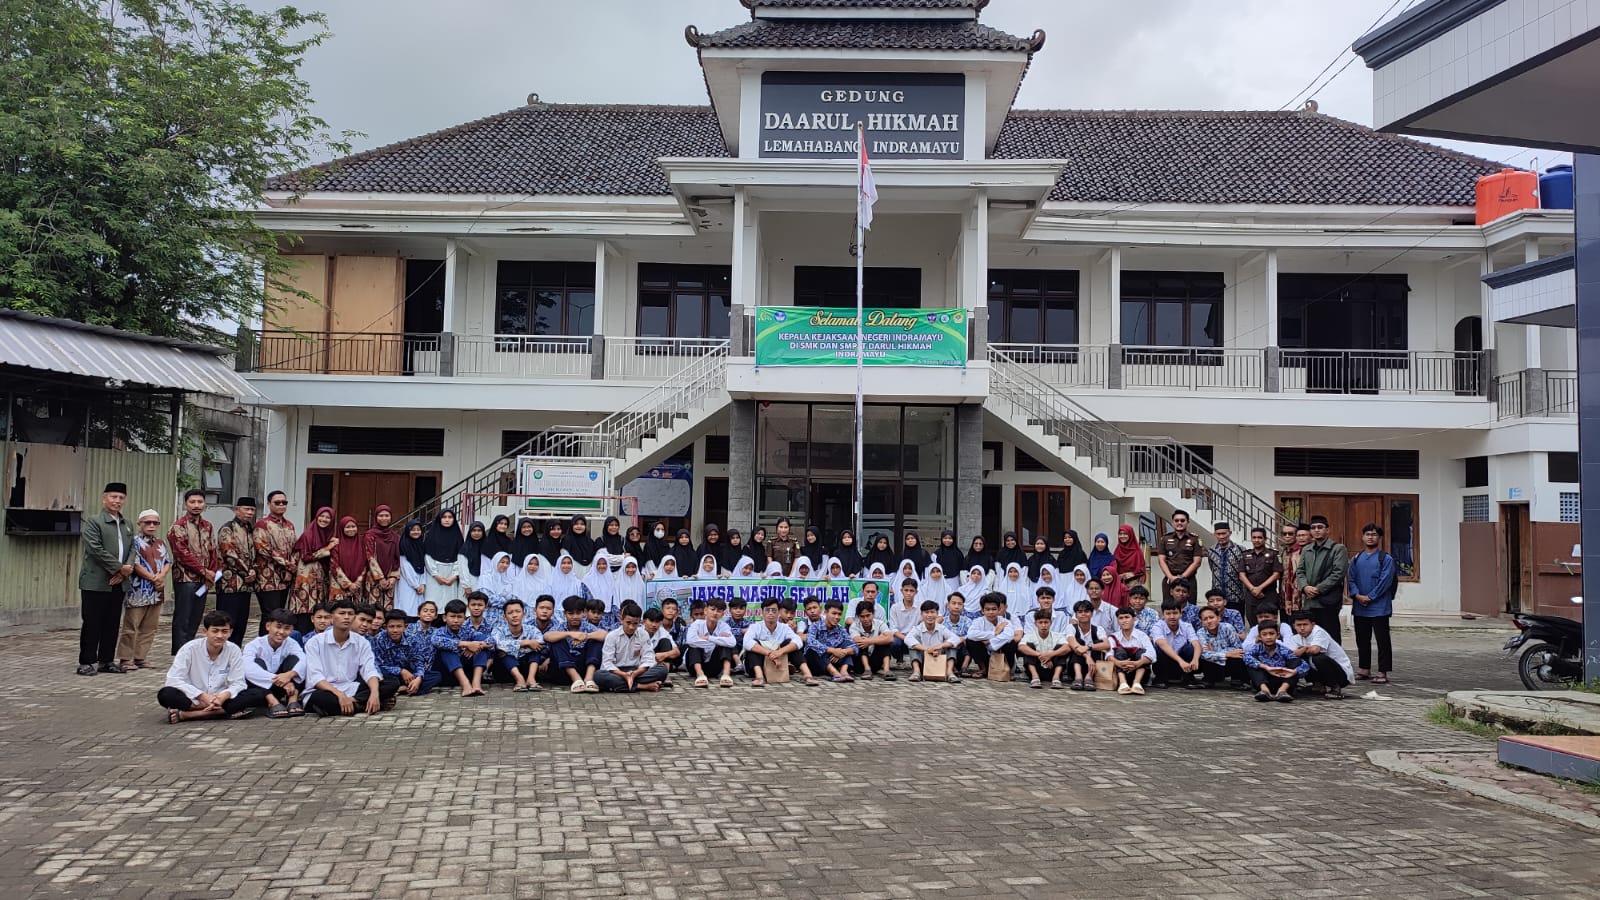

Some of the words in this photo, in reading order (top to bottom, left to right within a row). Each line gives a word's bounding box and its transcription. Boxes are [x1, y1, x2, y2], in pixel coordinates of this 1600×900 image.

[820, 90, 905, 103] GEDUNG
[764, 112, 854, 131] DAARUL
[867, 113, 959, 132] HIKMAH
[873, 141, 960, 154] INDRAMAYU
[865, 310, 918, 331] Datang
[778, 332, 810, 341] KEPALA
[861, 333, 891, 342] NEGERI
[892, 333, 944, 342] INDRAMAYU
[789, 342, 799, 350] DI
[800, 342, 818, 350] SMK
[819, 342, 838, 350] DAN
[868, 342, 897, 351] DARUL
[897, 342, 932, 351] HIKMAH
[688, 585, 735, 603] JAKSA
[738, 585, 787, 603] MASUK
